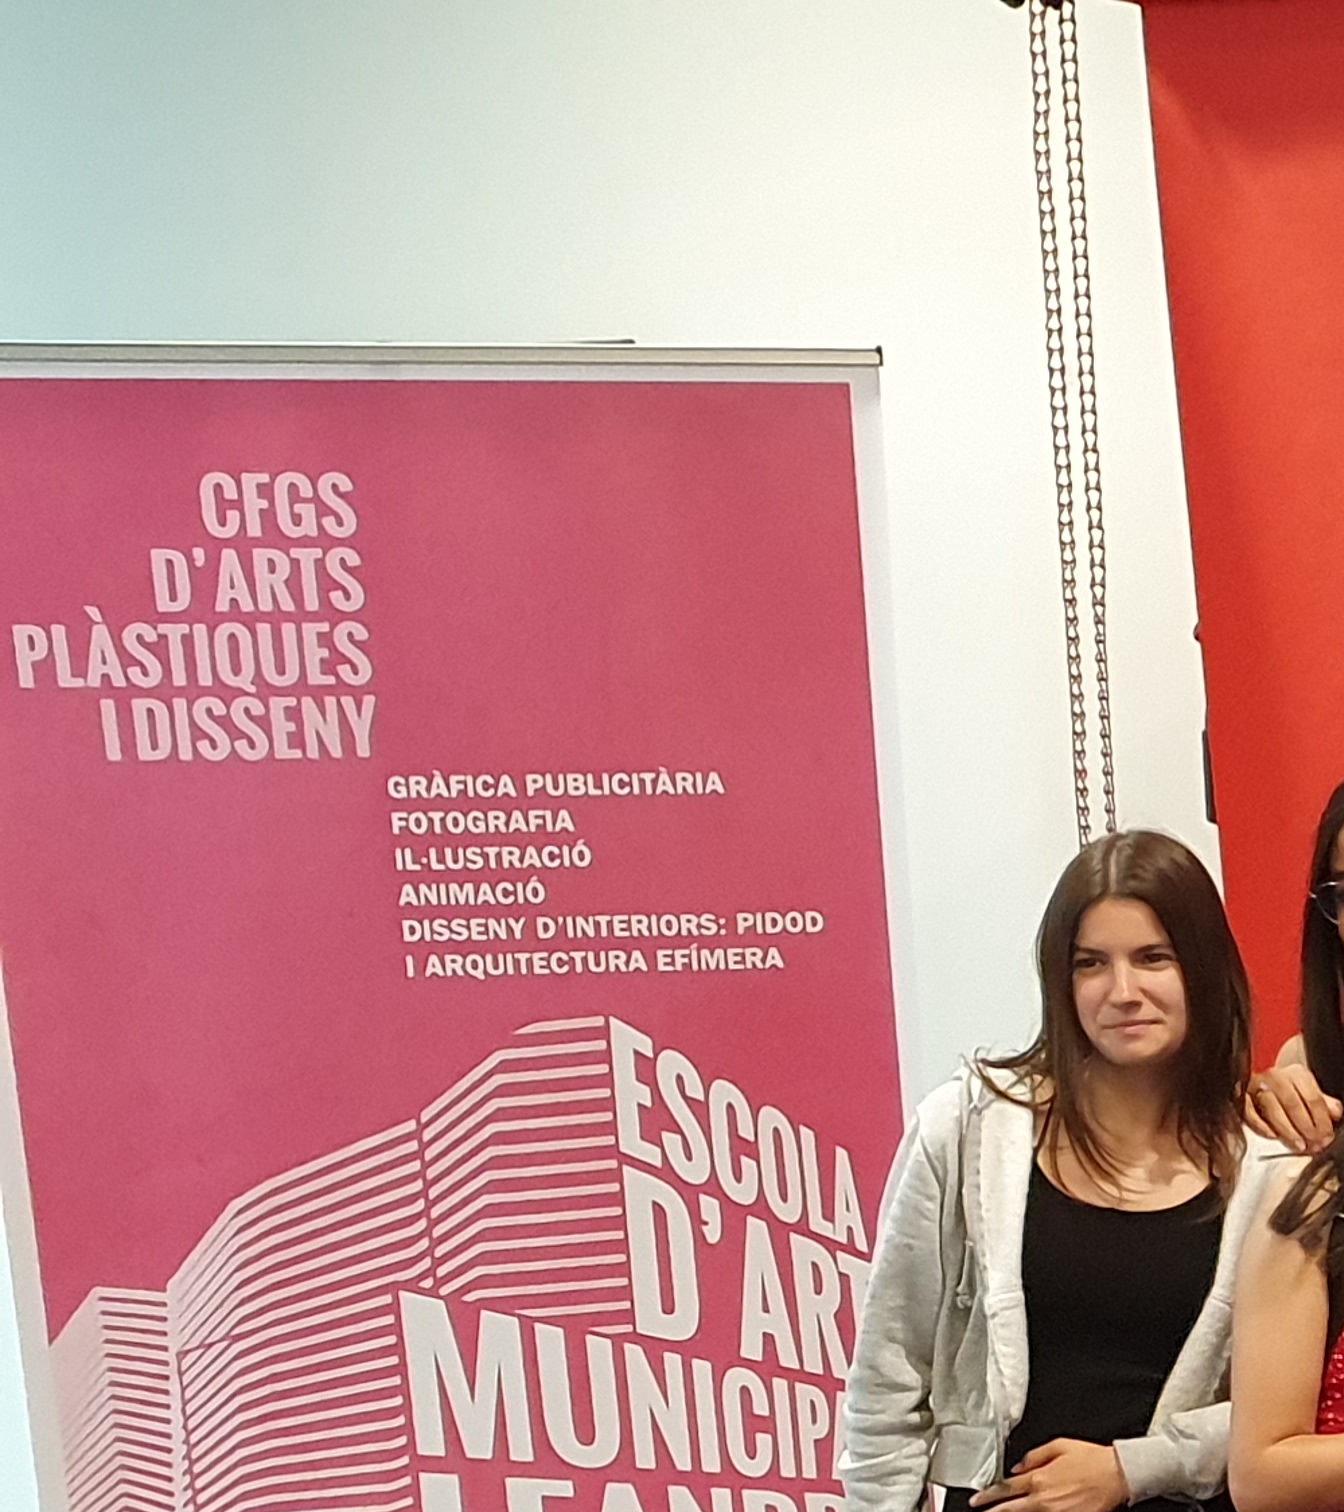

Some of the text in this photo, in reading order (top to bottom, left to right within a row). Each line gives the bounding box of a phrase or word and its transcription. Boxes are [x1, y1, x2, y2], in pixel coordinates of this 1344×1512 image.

[200, 471, 357, 538] CFGS
[151, 547, 366, 613] D'ARTS
[12, 605, 373, 693] PLÀSTIQUES
[100, 695, 376, 761] I DISSENY
[387, 766, 725, 799] GRÀFICA PUBLICITÀRIA
[390, 809, 576, 835] FOTOGRAFIA
[394, 839, 592, 871] IL·LUSTRACIÓ
[399, 876, 546, 906] ANIMACIÓ
[402, 910, 824, 942] DISSENY D'INTERIORS: PIDOD
[405, 944, 785, 980] I ARQUITECTURA EFÍMERA
[609, 1015, 868, 1253] ESCOLA
[399, 1289, 845, 1479] MUNICIP
